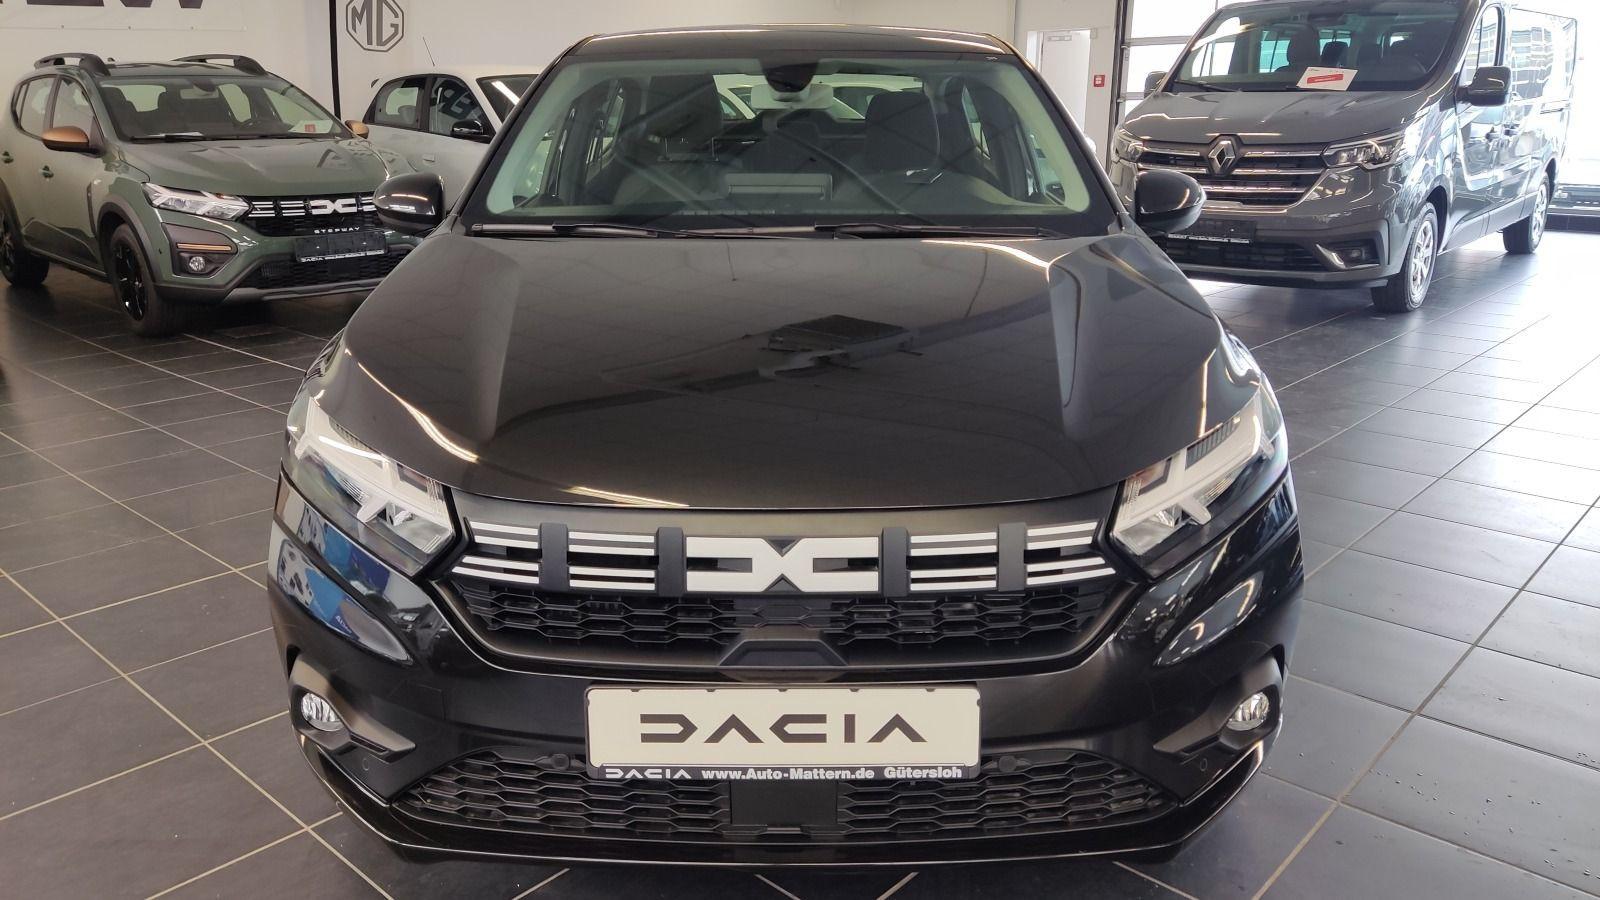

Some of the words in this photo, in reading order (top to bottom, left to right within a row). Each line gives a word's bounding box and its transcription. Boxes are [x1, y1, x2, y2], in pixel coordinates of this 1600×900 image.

[351, 0, 399, 46] MG
[640, 713, 928, 743] DACIA
[605, 768, 692, 779] DACIA
[701, 767, 875, 780] www.Auto-Mattern.de
[884, 766, 962, 779] Gütersloh
